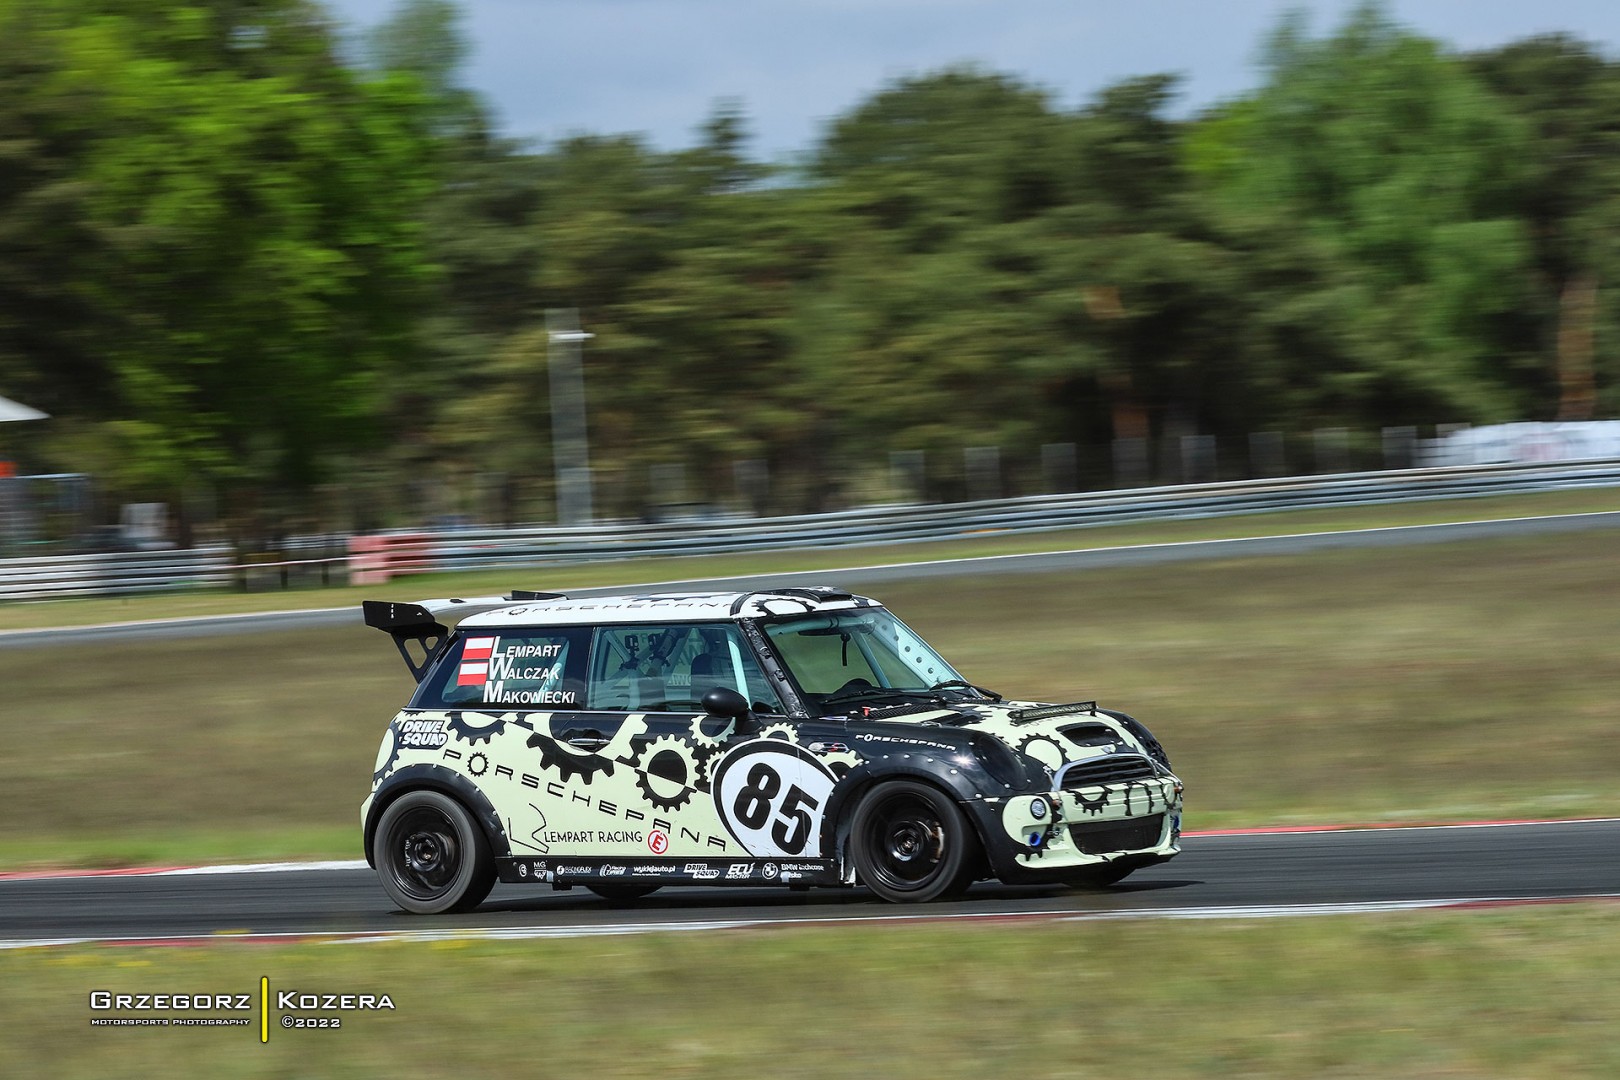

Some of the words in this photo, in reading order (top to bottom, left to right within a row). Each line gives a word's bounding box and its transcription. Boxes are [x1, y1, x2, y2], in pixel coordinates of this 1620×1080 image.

[491, 635, 561, 659] LEMPART
[489, 656, 560, 681] WALCZAK
[482, 680, 575, 704] MAKOWIECKI
[402, 720, 443, 733] DRIVE
[402, 732, 448, 746] SQUAD
[855, 733, 957, 751] PORSCHEPANA
[442, 748, 727, 852] PORSCHEPANA
[733, 762, 819, 855] 85
[543, 830, 594, 843] LEMPART
[598, 830, 643, 843] RACING
